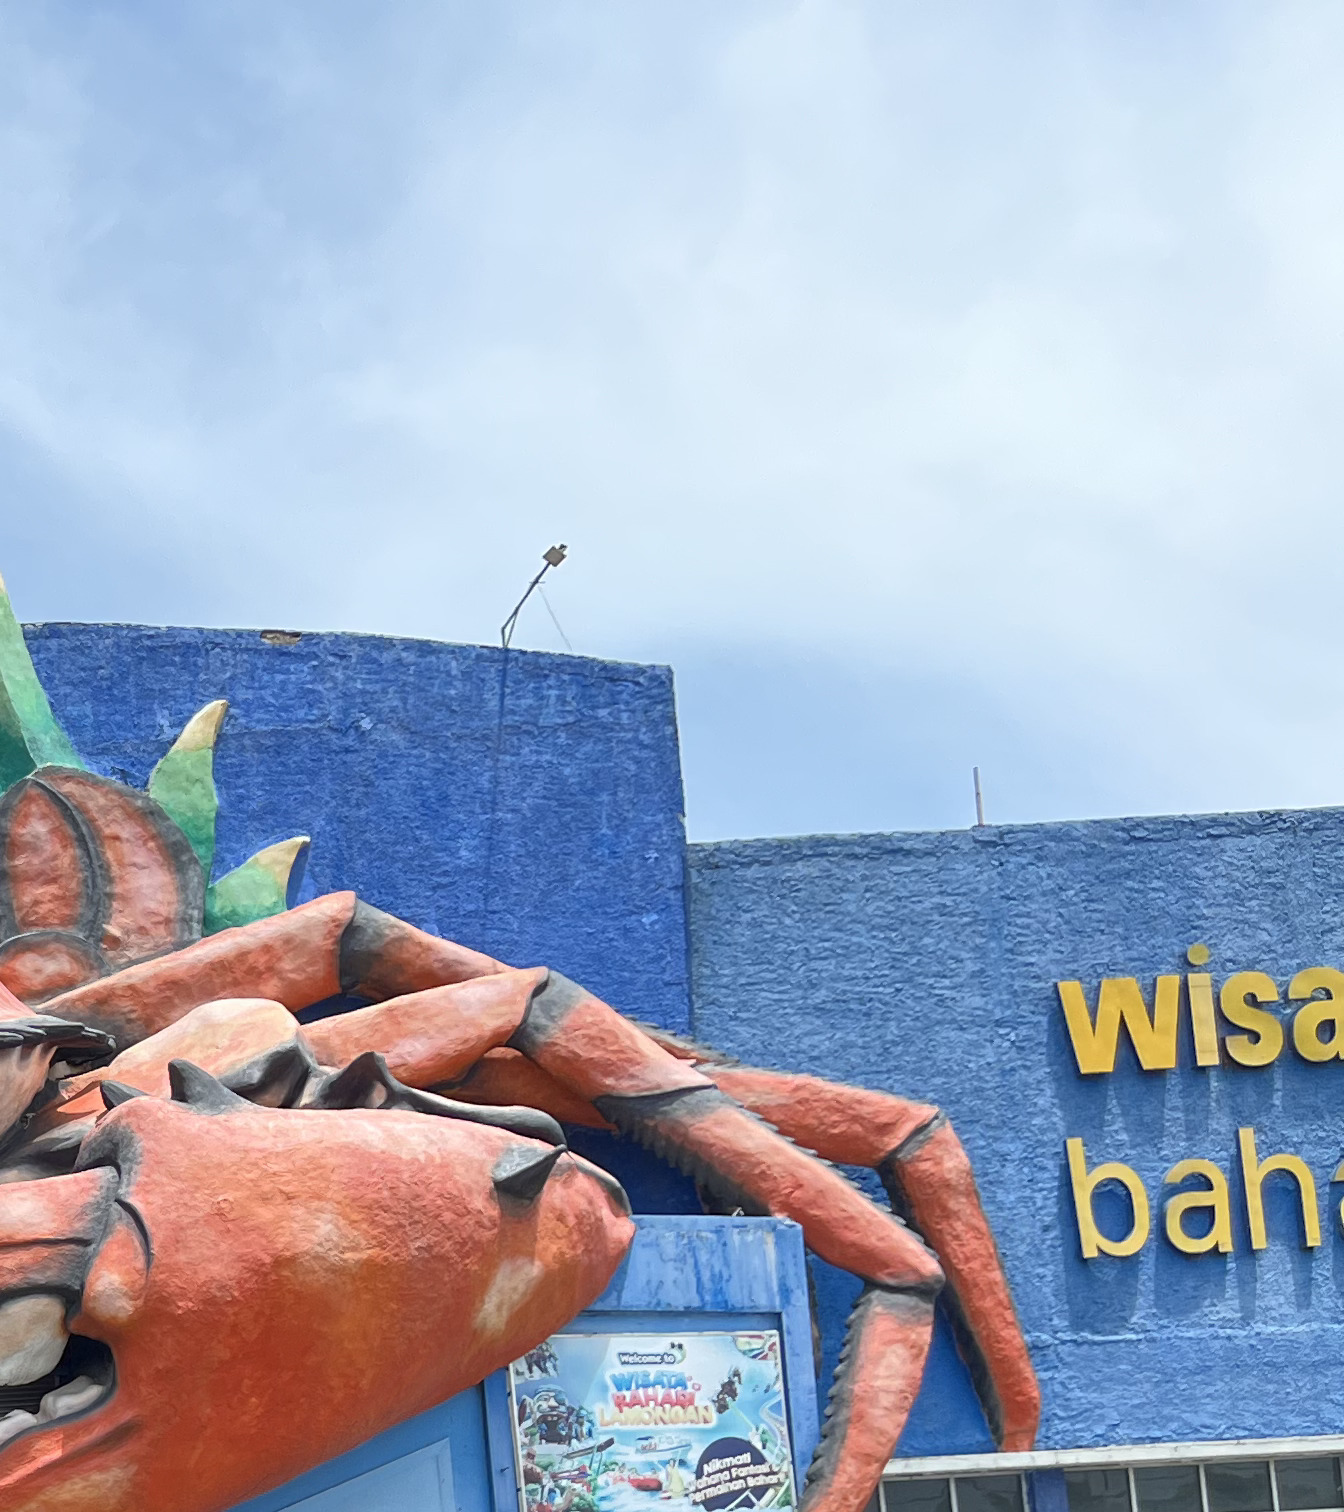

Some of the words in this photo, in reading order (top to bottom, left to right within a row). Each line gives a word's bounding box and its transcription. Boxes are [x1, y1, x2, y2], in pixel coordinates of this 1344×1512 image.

[1056, 943, 1344, 1075] wisa
[1064, 1127, 1344, 1260] bah
[619, 1352, 663, 1365] Welcome
[663, 1352, 676, 1364] to
[610, 1371, 688, 1391] WISATA
[703, 1452, 752, 1475] Nikmati
